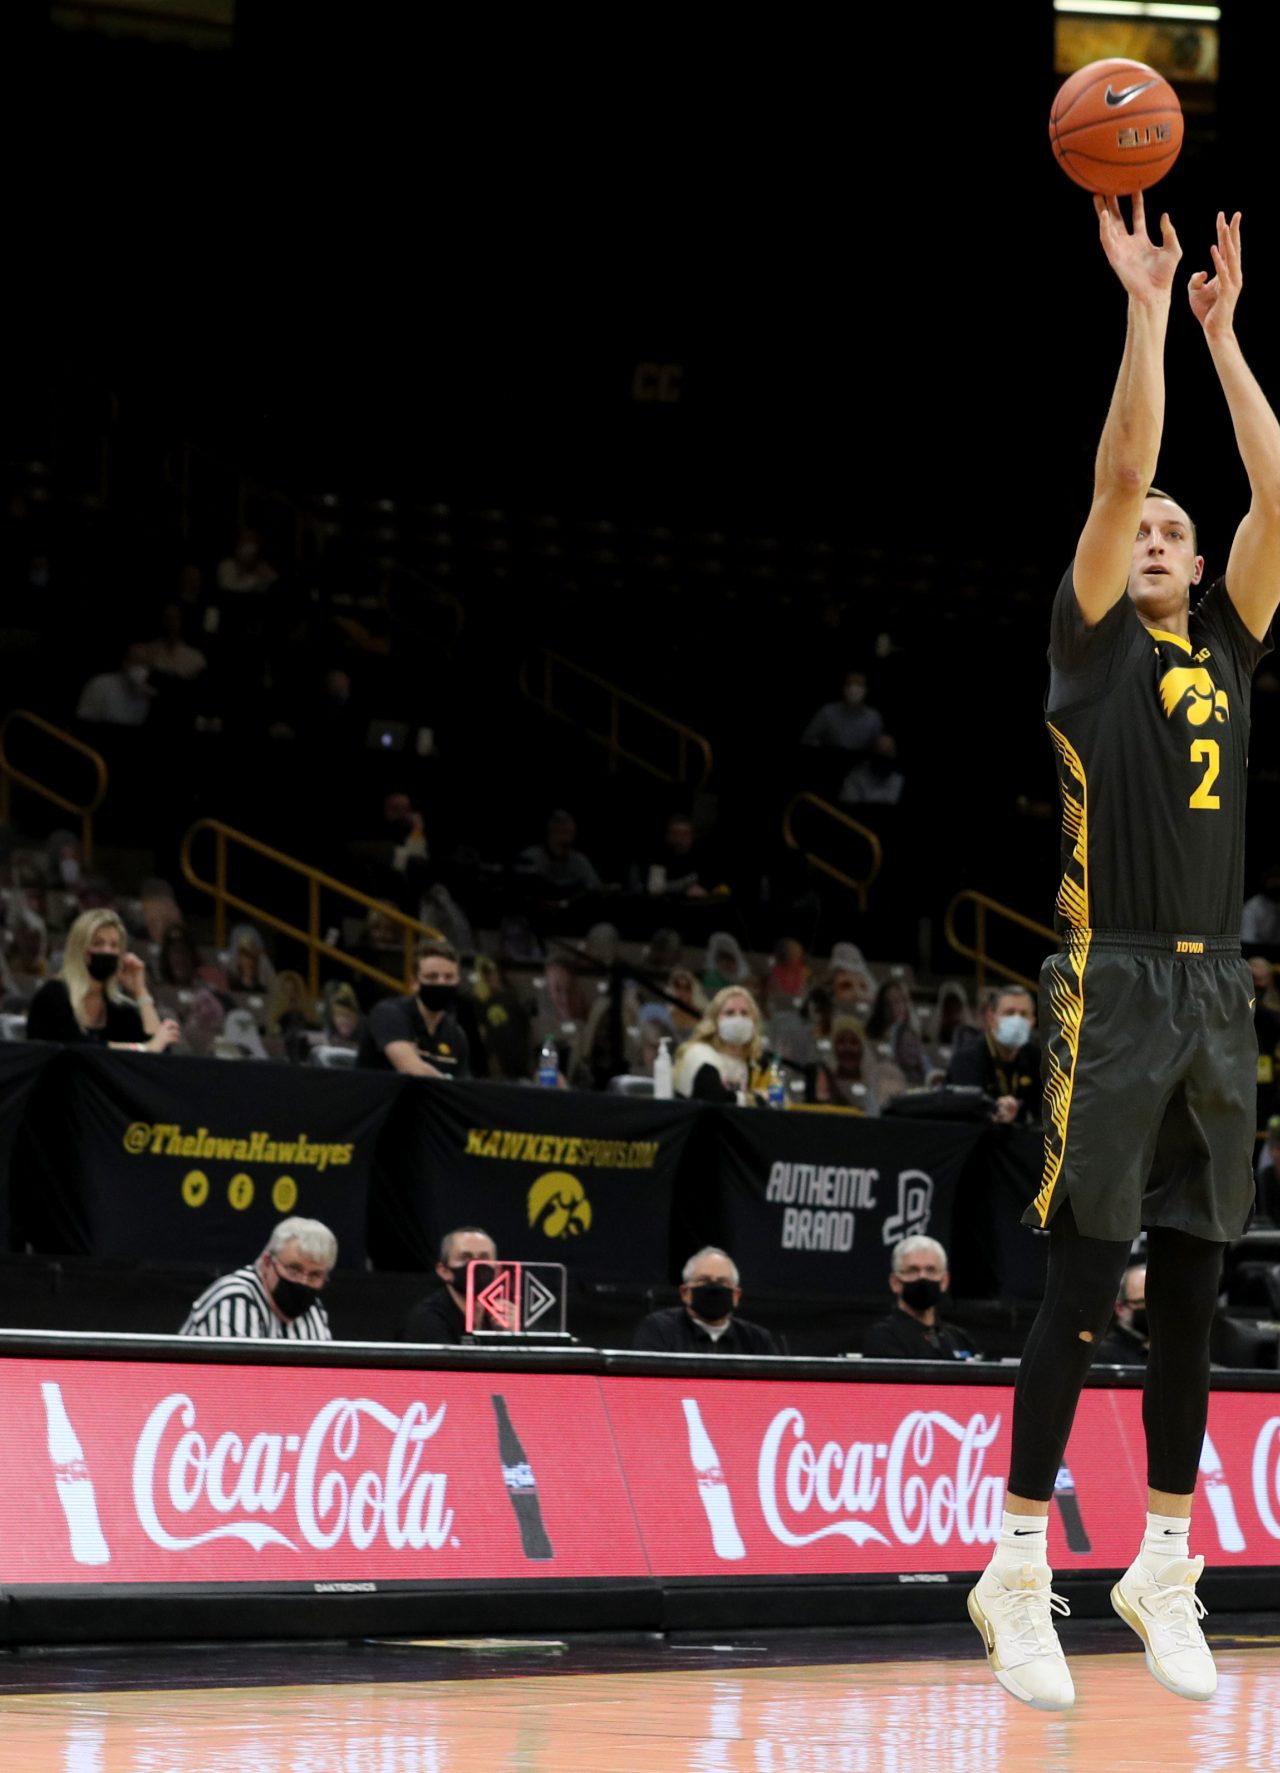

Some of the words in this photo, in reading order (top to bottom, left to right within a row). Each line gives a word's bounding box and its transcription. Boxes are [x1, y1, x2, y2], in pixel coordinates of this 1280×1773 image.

[1189, 738, 1221, 809] 2
[1176, 941, 1204, 954] IOWA
[123, 1121, 355, 1172] @TheIowaHawkeyes
[766, 1161, 879, 1209] AUTHENTIC
[781, 1207, 855, 1252] BRAND
